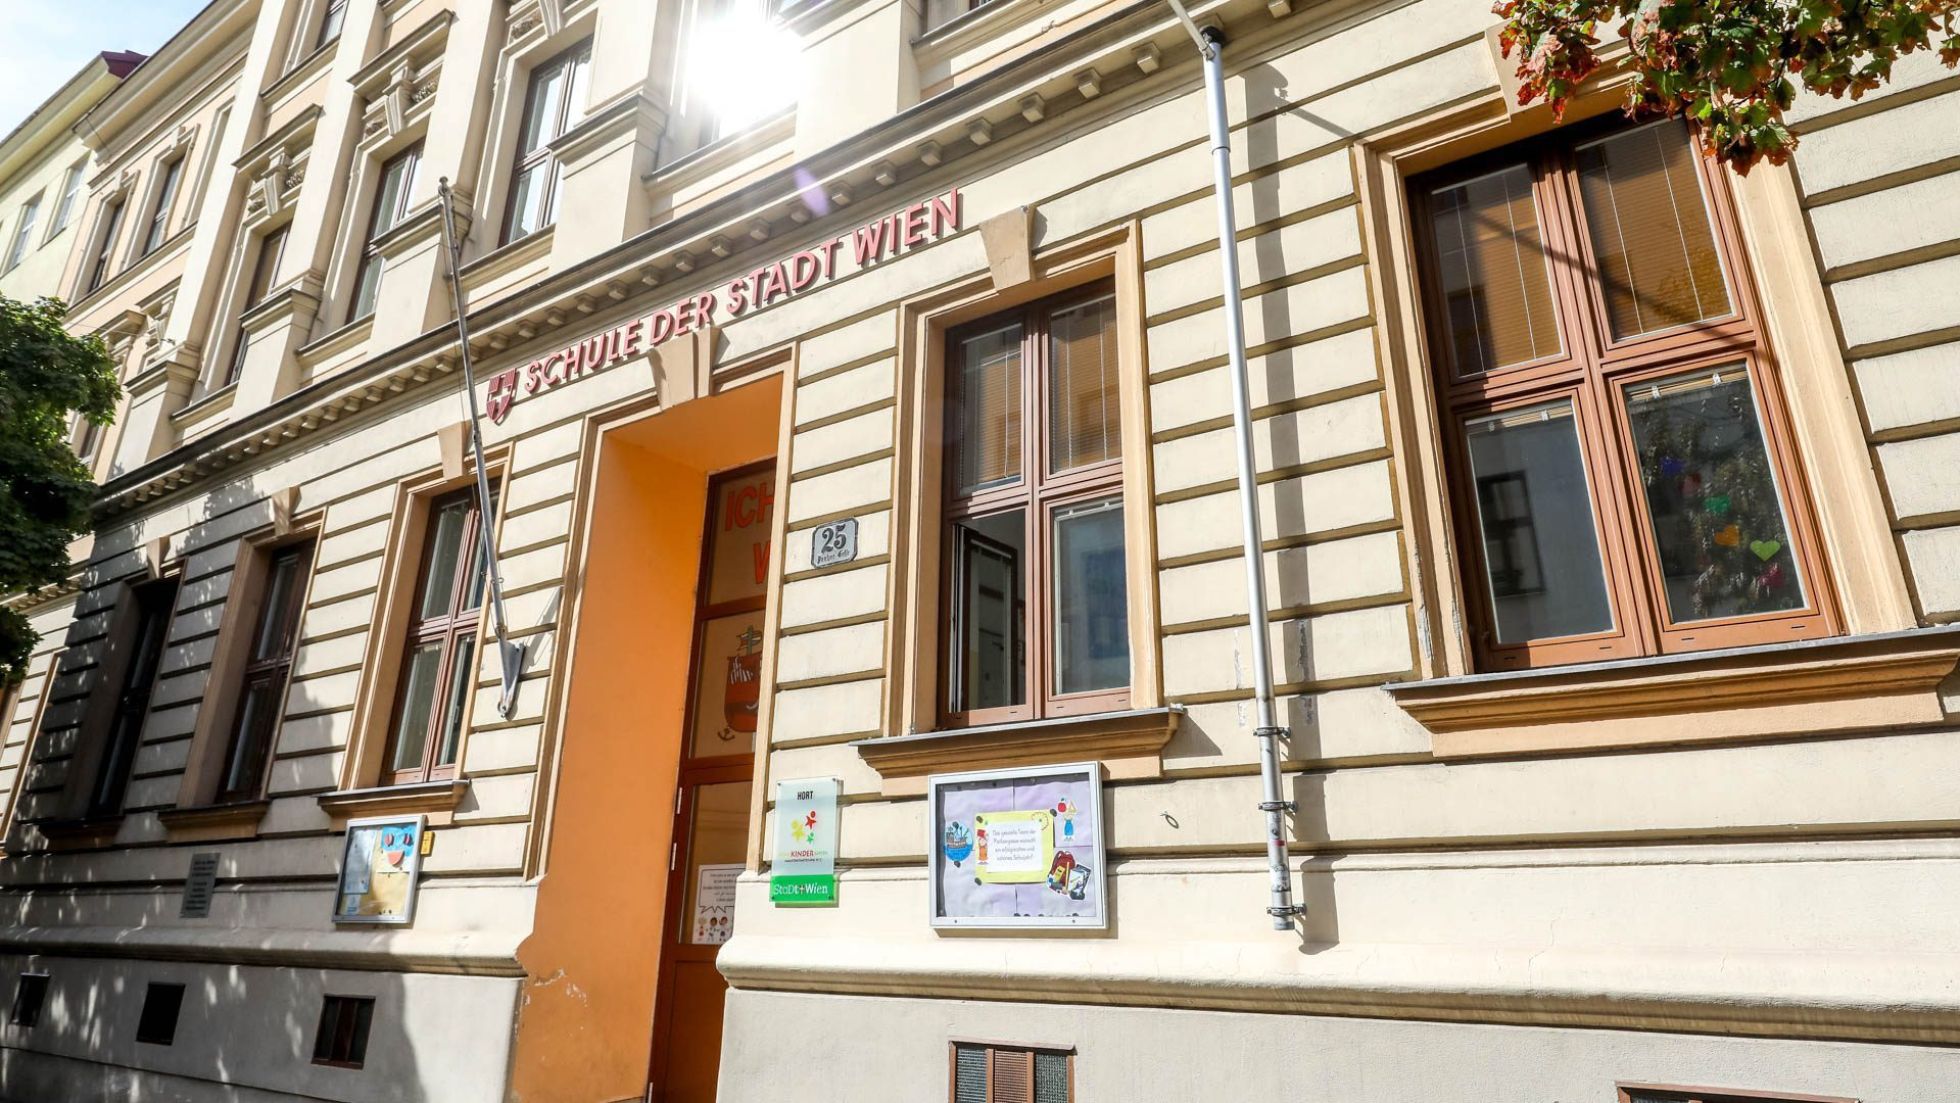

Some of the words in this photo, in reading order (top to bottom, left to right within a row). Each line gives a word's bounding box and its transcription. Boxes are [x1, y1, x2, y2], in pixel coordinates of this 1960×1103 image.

[523, 318, 642, 394] SCHULE
[648, 291, 717, 347] DER
[725, 237, 843, 316] STADT
[851, 188, 960, 266] WIEN
[821, 524, 847, 553] 25
[797, 790, 814, 800] HORT
[791, 850, 814, 858] KINDER
[805, 882, 829, 894] Wien
